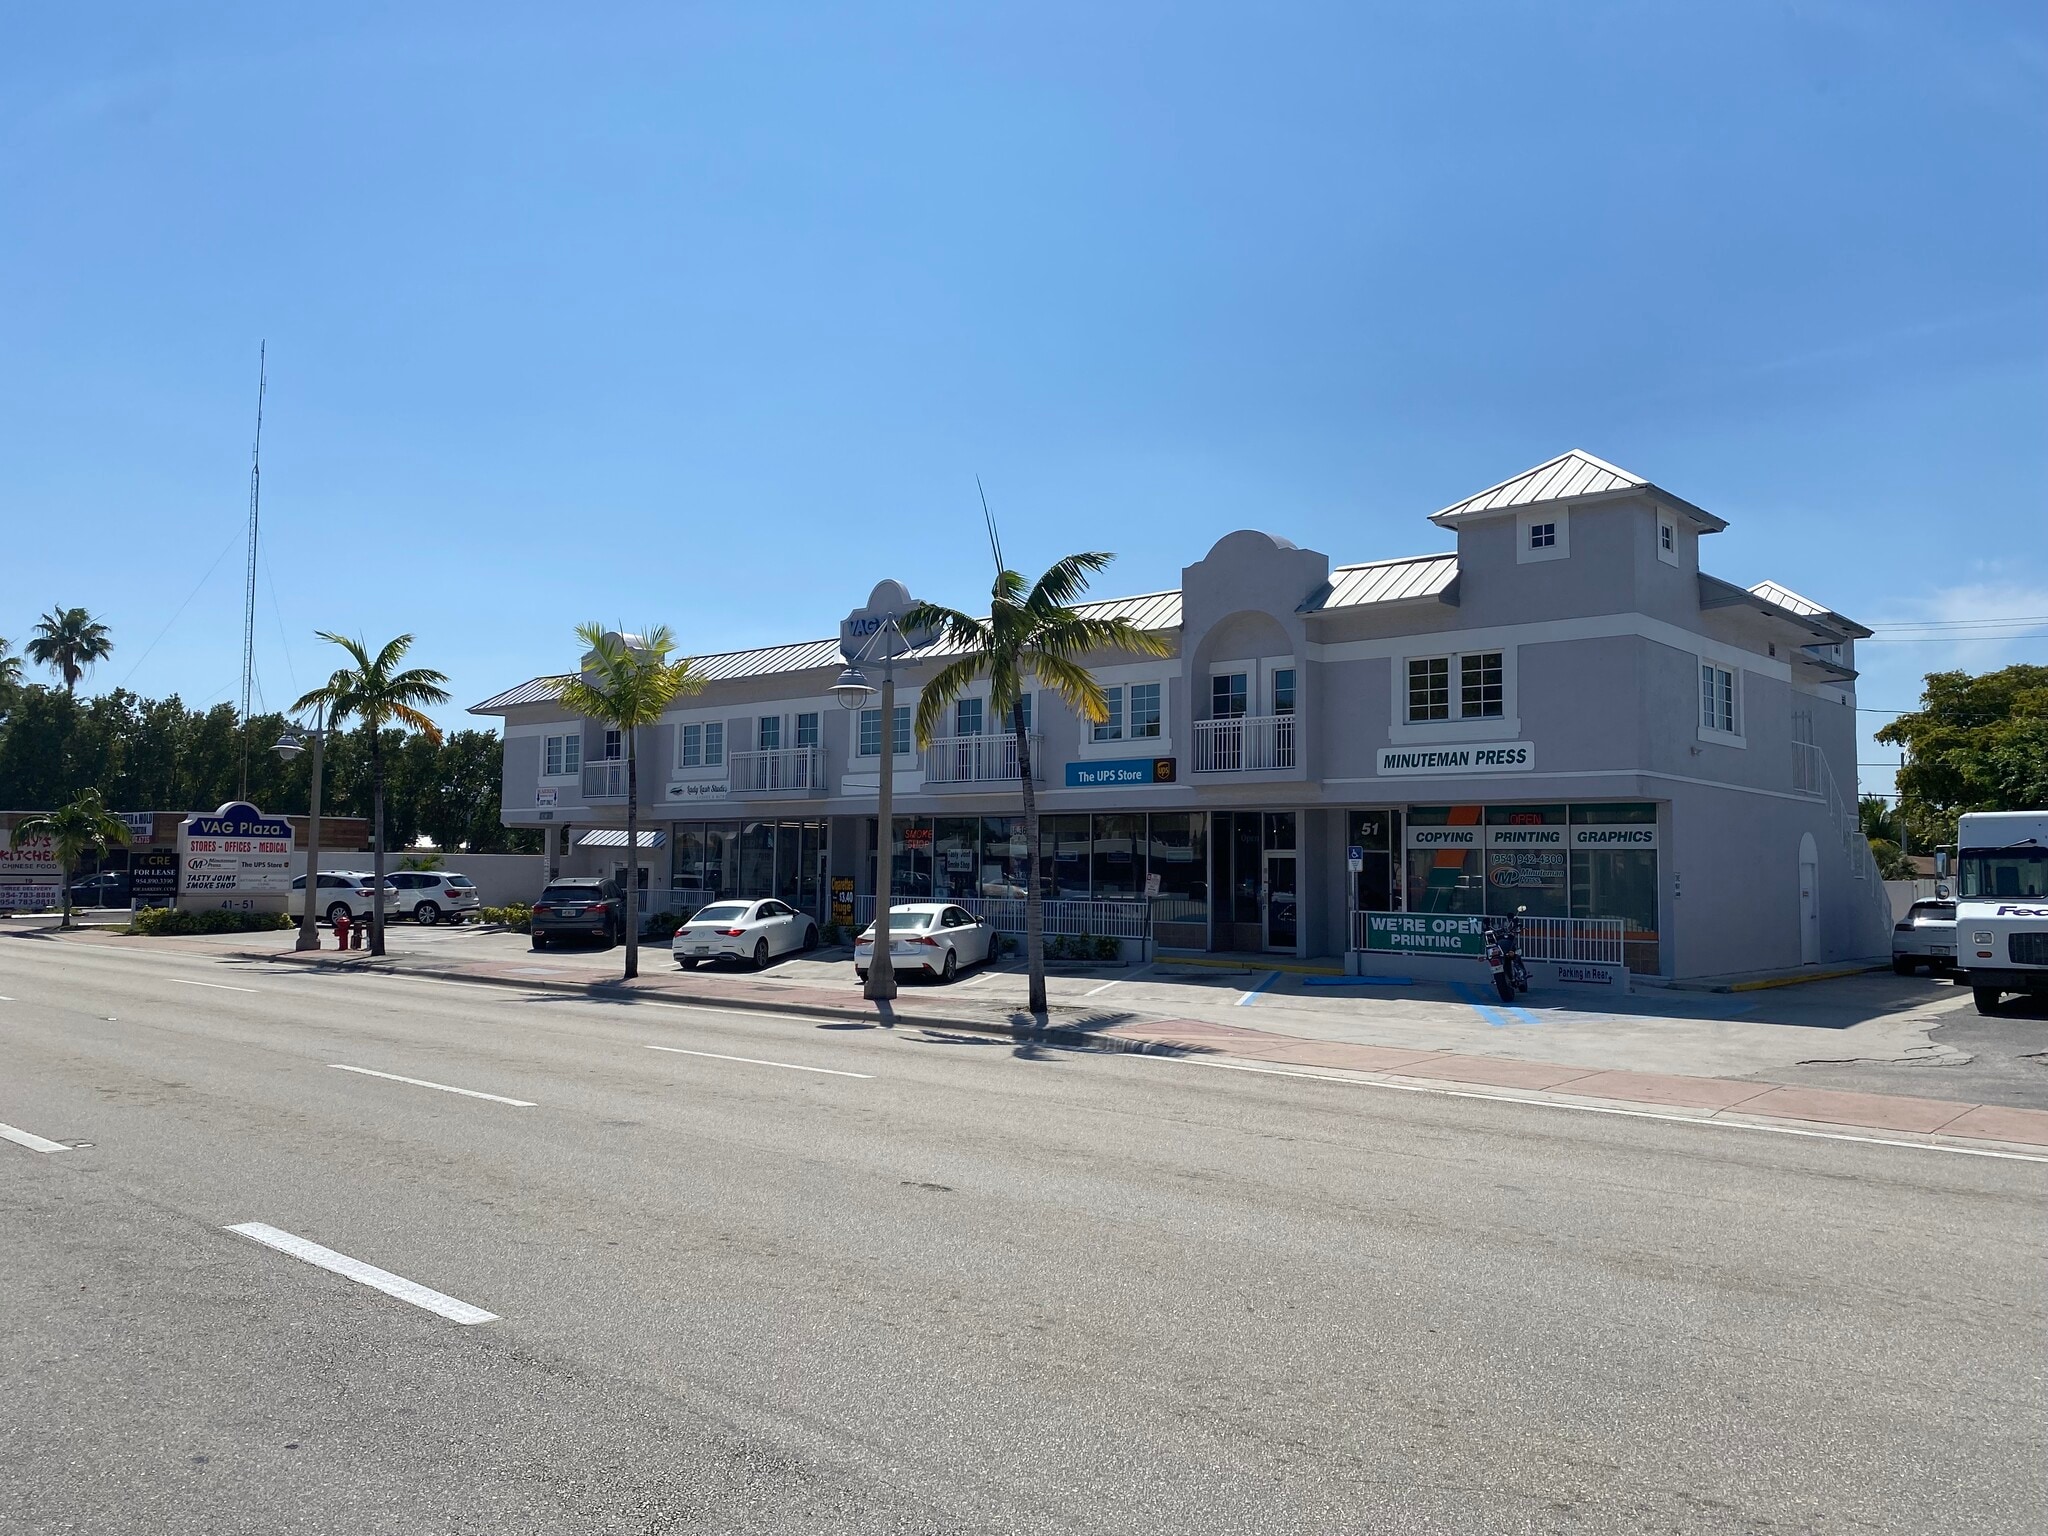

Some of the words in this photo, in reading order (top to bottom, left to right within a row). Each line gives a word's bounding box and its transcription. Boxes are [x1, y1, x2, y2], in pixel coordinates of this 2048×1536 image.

[1384, 752, 1470, 769] MINUTEMAN
[1475, 748, 1527, 765] PRESS
[1079, 771, 1095, 782] The
[1097, 770, 1115, 781] UPS
[1117, 769, 1142, 780] Store
[1510, 814, 1541, 825] OPEN
[201, 821, 234, 834] VAG
[1361, 822, 1379, 835] 51
[905, 829, 933, 839] SMOKE
[1416, 832, 1474, 843] COPYING
[1494, 831, 1560, 843] PRINTING
[1577, 831, 1653, 843] GRAPHICS
[191, 840, 216, 852] STORES
[224, 841, 251, 852] OFFICES
[259, 842, 287, 853] MEDICAL
[0, 850, 57, 861] KITCHE
[149, 857, 171, 865] CRE
[1491, 854, 1516, 865] (954)
[1517, 853, 1564, 864] 942-4300
[1520, 867, 1564, 877] Minuteman
[833, 900, 851, 915] Huge
[1371, 917, 1426, 932] WE'RE
[1432, 920, 1482, 935] OPEN
[1391, 934, 1462, 948] PRINTING
[1558, 967, 1584, 980] Parking
[1592, 969, 1609, 979] Rear
